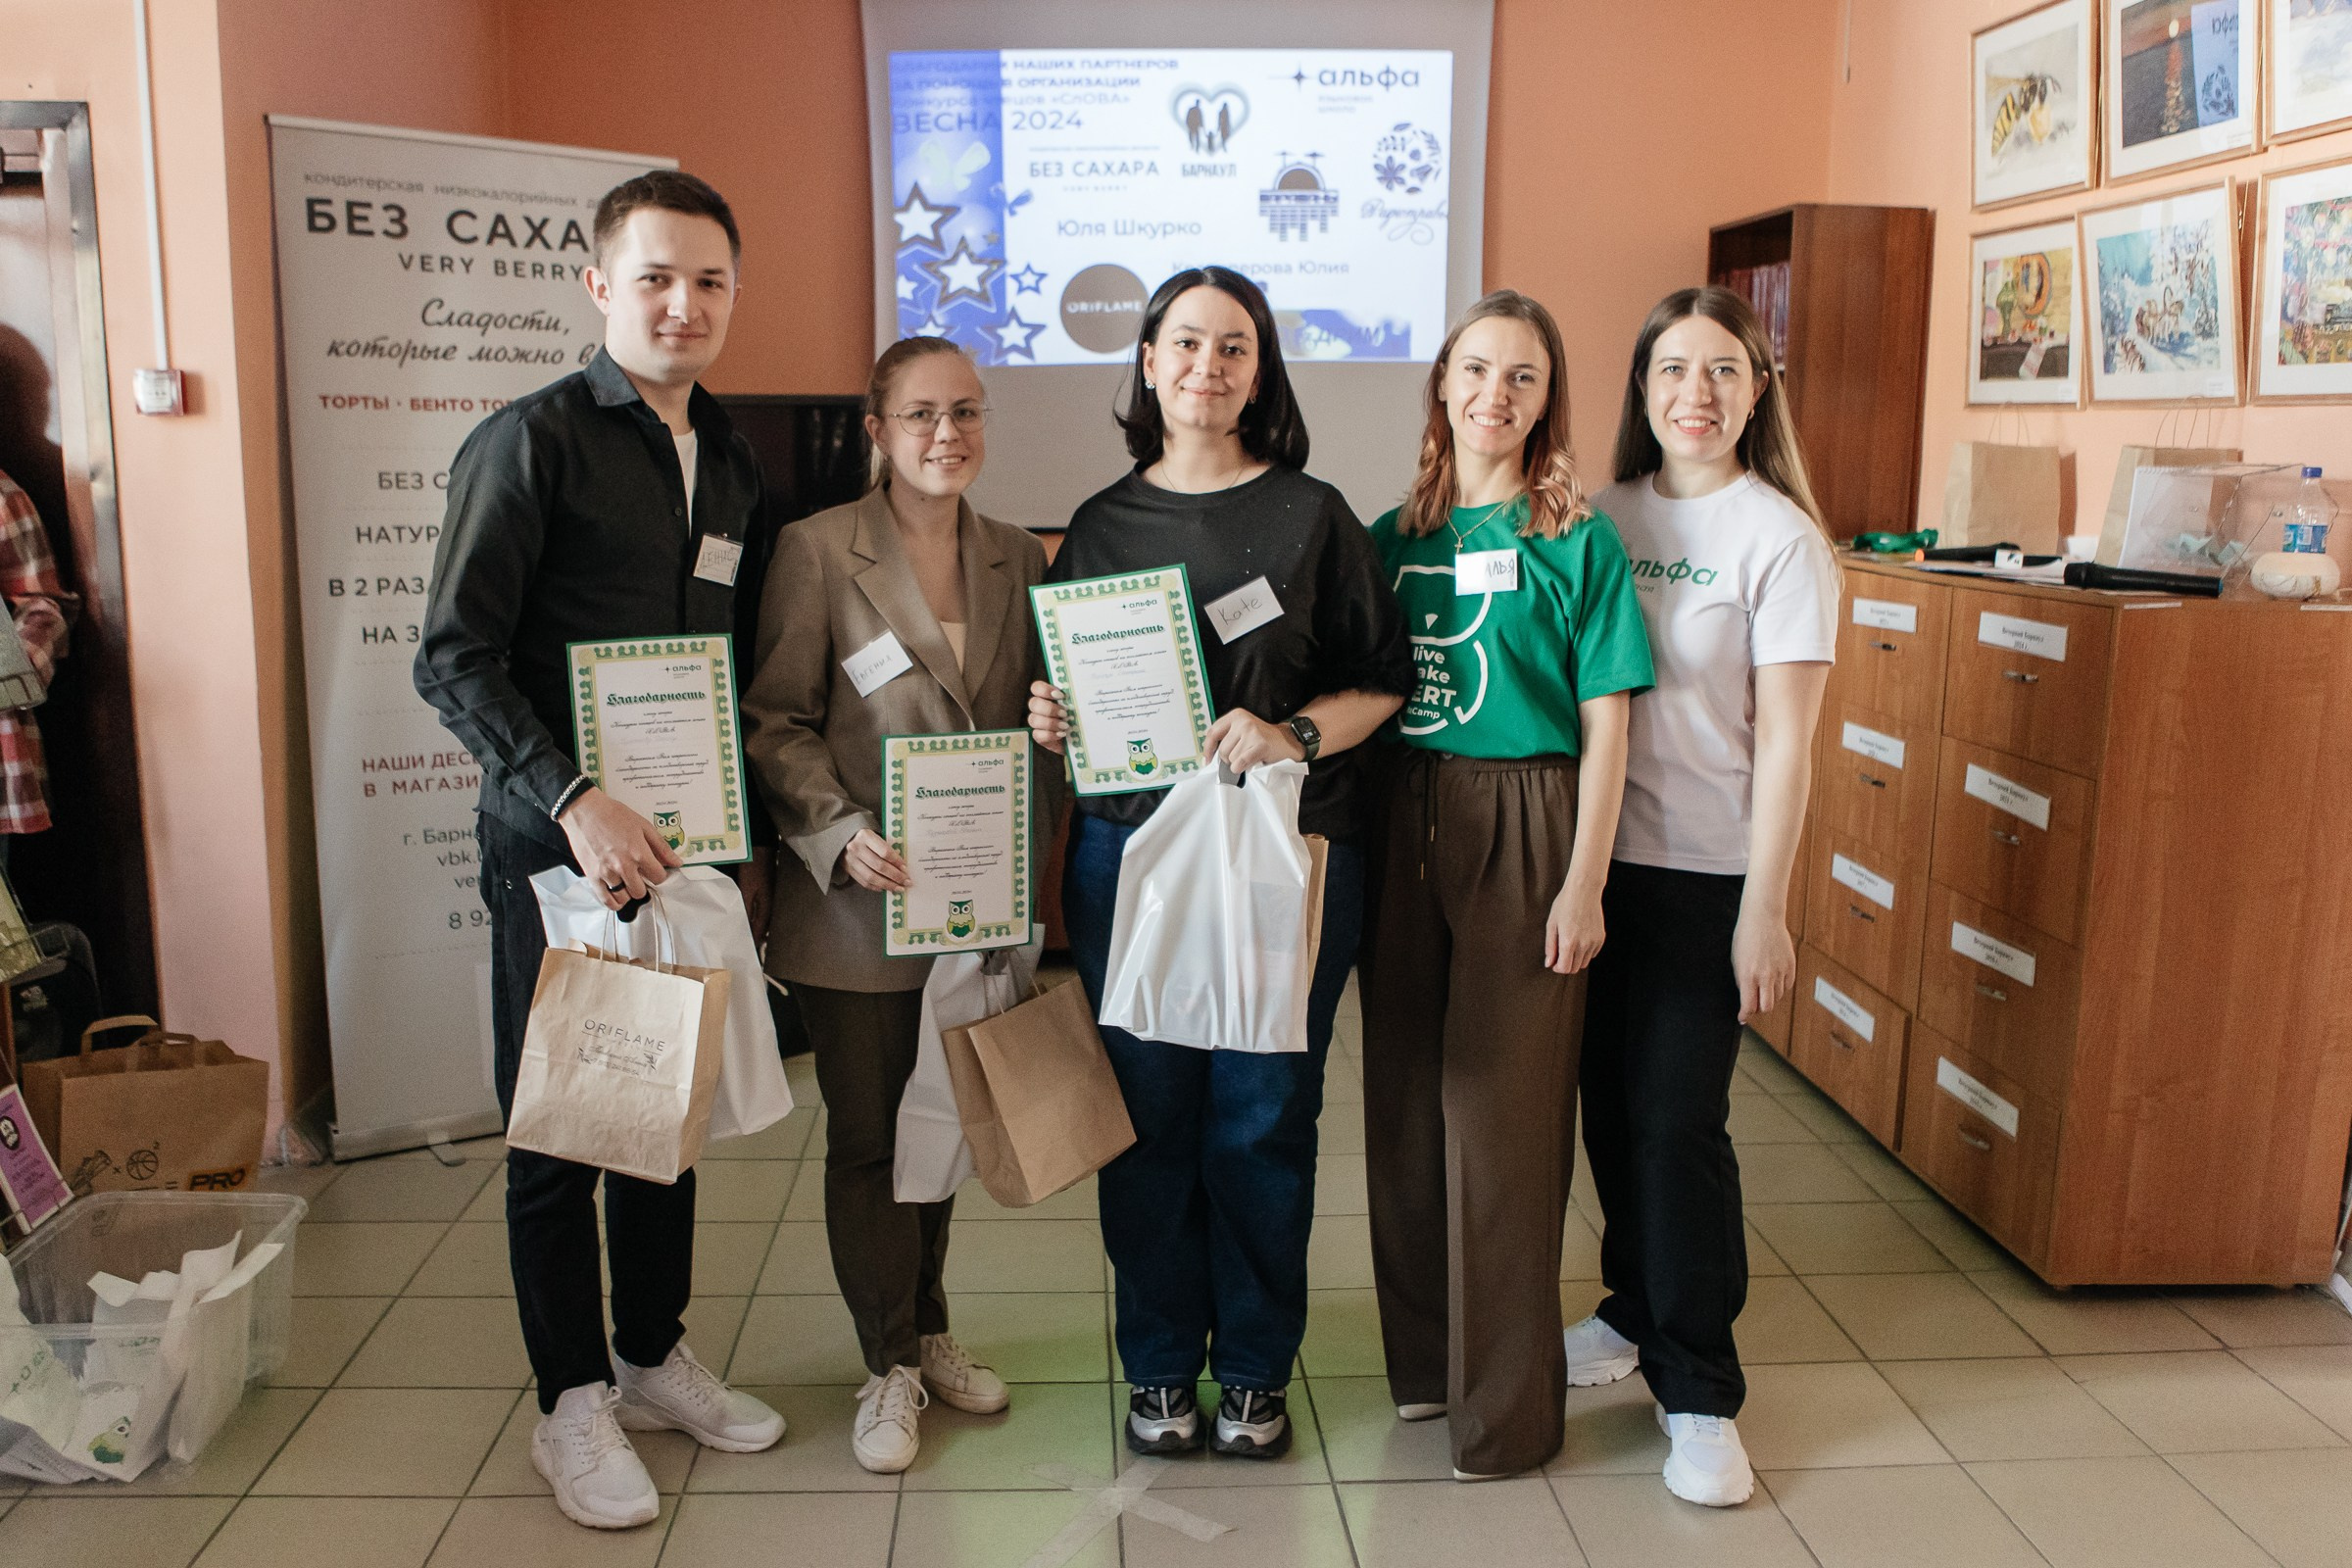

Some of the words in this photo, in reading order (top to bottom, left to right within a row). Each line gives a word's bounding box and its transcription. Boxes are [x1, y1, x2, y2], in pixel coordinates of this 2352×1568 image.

[1013, 60, 1075, 71] НАШИХ
[1080, 60, 1179, 71] ПАРТНЕРОВ
[1017, 77, 1141, 89] ОРГАНИЗАЦИИ
[1318, 66, 1420, 92] альфа
[893, 111, 1001, 134] ВЕСНА
[1011, 111, 1084, 130] 2024
[1029, 161, 1064, 178] БЕЗ
[1072, 161, 1159, 178] САХАРА
[1182, 163, 1237, 178] БАРНАУЛ
[303, 172, 424, 193] кондитерская
[306, 197, 410, 239] БЕЗ
[446, 209, 589, 254] САХА
[1057, 220, 1105, 237] Юля
[1114, 219, 1202, 240] Шкурко
[398, 252, 474, 274] VERY
[494, 259, 584, 281] BERRY
[1298, 260, 1349, 274] Юлия
[420, 297, 570, 336] Сладости,
[1066, 301, 1144, 314] ORIFLAME
[326, 335, 458, 368] которые
[468, 344, 565, 366] можно
[578, 342, 596, 366] в
[318, 395, 389, 411] ТОРТЫ
[410, 396, 474, 413] БЕНТО
[378, 471, 423, 490] БЕЗ
[433, 471, 449, 490] С
[356, 525, 440, 544] НАТУР
[1629, 557, 1718, 586] льфа
[328, 578, 345, 597] В
[355, 578, 368, 596] 2
[376, 577, 424, 595] РАЗ
[1129, 599, 1157, 610] альфа
[362, 626, 397, 644] НА
[1071, 624, 1164, 645] Благодарность
[1417, 664, 1450, 684] ake
[607, 691, 706, 707] Благодарность
[1411, 685, 1456, 708] ERT
[362, 755, 425, 773] НАШИ
[364, 783, 377, 798] В
[392, 774, 479, 795] МАГАЗИ
[915, 785, 1005, 800] Благодарность
[423, 828, 478, 846] Барн
[449, 911, 463, 930] 8
[584, 1019, 665, 1052] ORIFLAME
[189, 1167, 245, 1191] PRO
